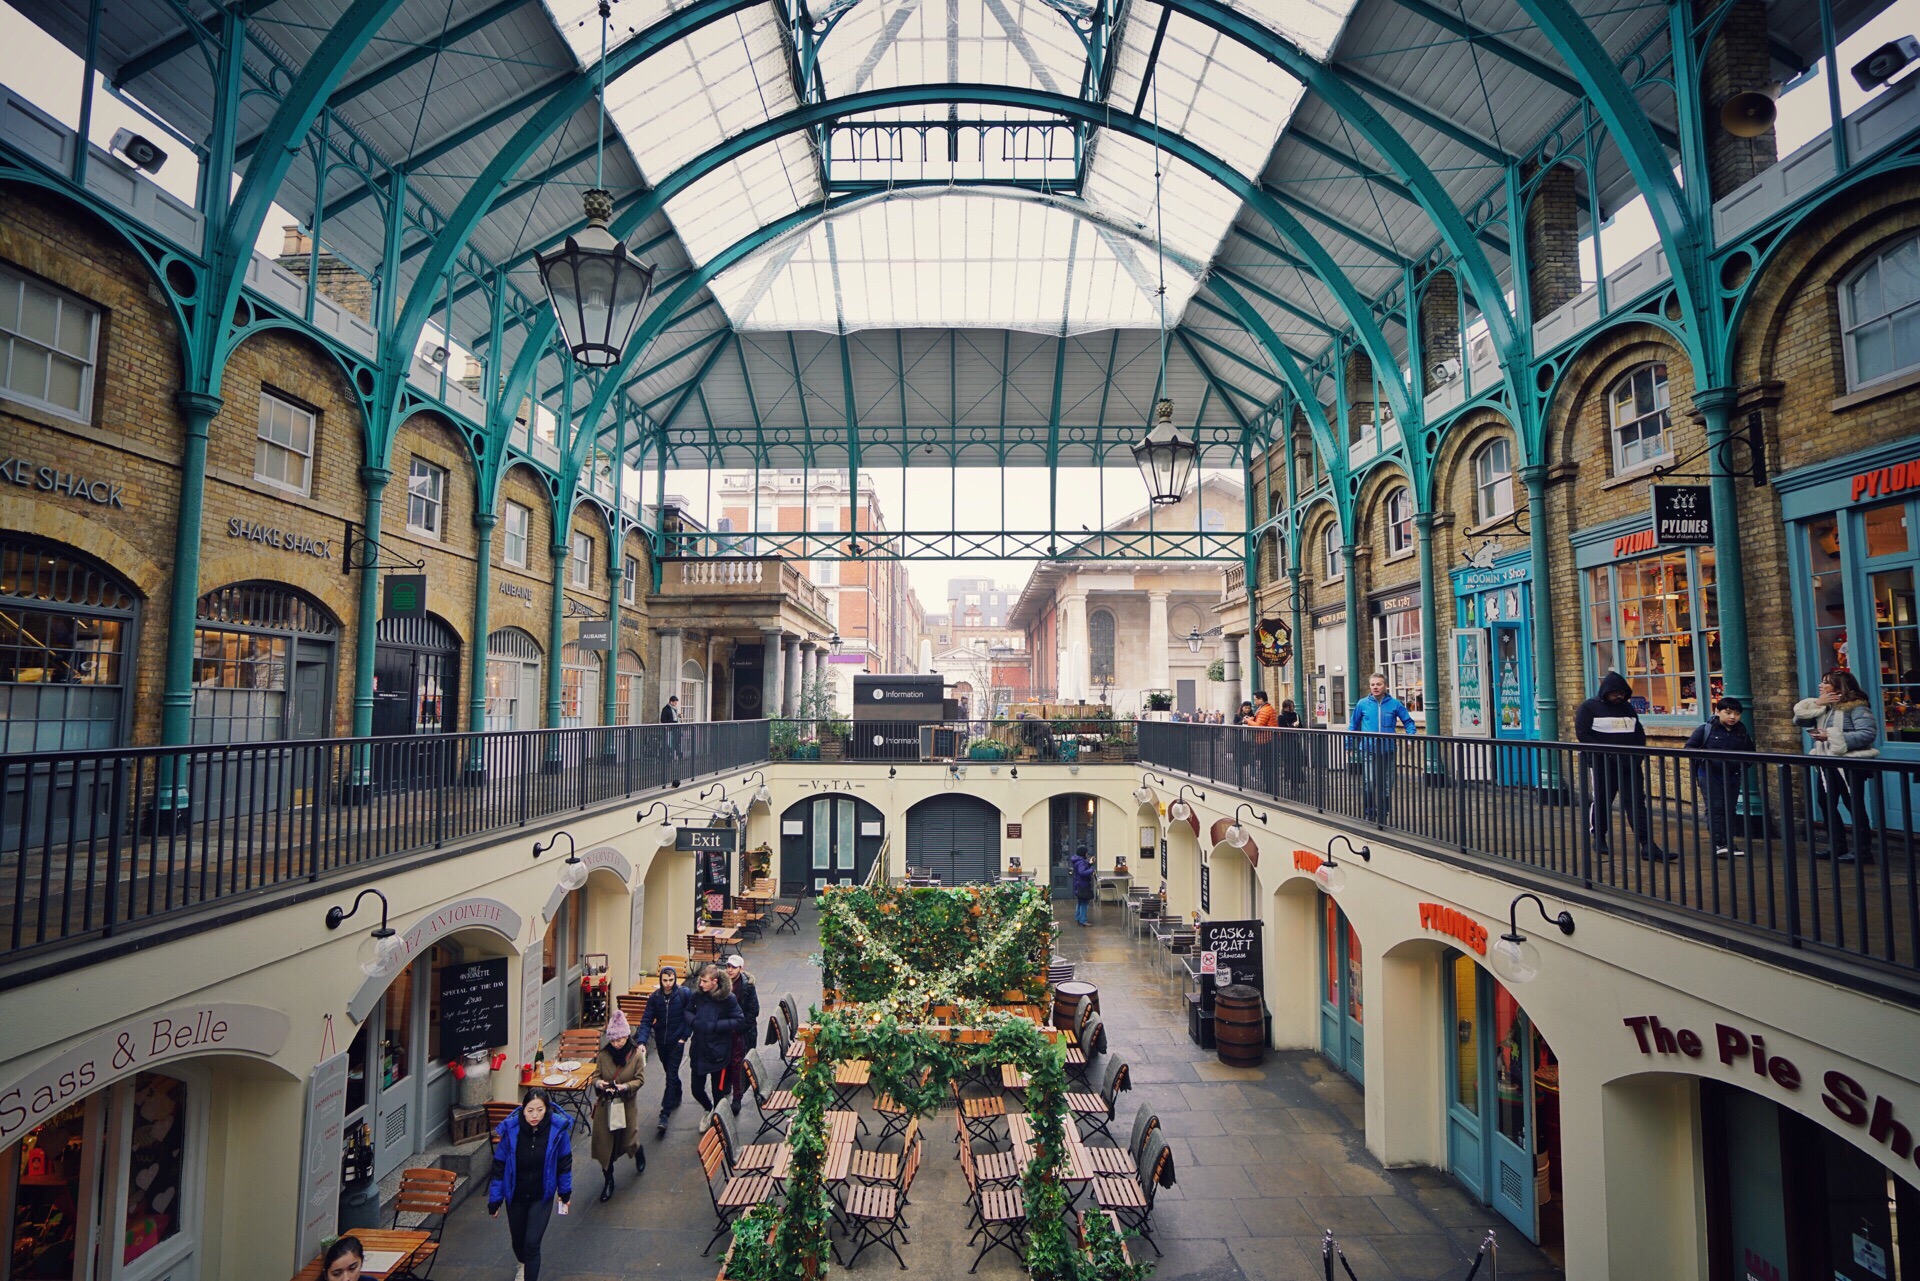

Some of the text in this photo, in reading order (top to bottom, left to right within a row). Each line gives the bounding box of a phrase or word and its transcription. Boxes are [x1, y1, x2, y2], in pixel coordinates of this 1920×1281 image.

[37, 466, 124, 508] SHACK
[1661, 519, 1708, 533] PYLONES
[228, 517, 331, 559] SHAKE SHACK
[1467, 573, 1500, 584] MOOMIN
[1508, 567, 1526, 579] Shop
[500, 582, 532, 600] AUBAINE
[690, 832, 721, 847] Exit
[428, 904, 503, 935] ANTOINETTE
[1209, 927, 1255, 940] CASK &
[1418, 903, 1488, 956] PYLONES
[1210, 939, 1254, 952] CRAFT
[443, 987, 468, 997] SPECIAL
[493, 980, 505, 988] DAY
[1623, 1015, 1703, 1058] The
[1715, 1022, 1801, 1090] Pie
[0, 1010, 228, 1137] Sass & Belle
